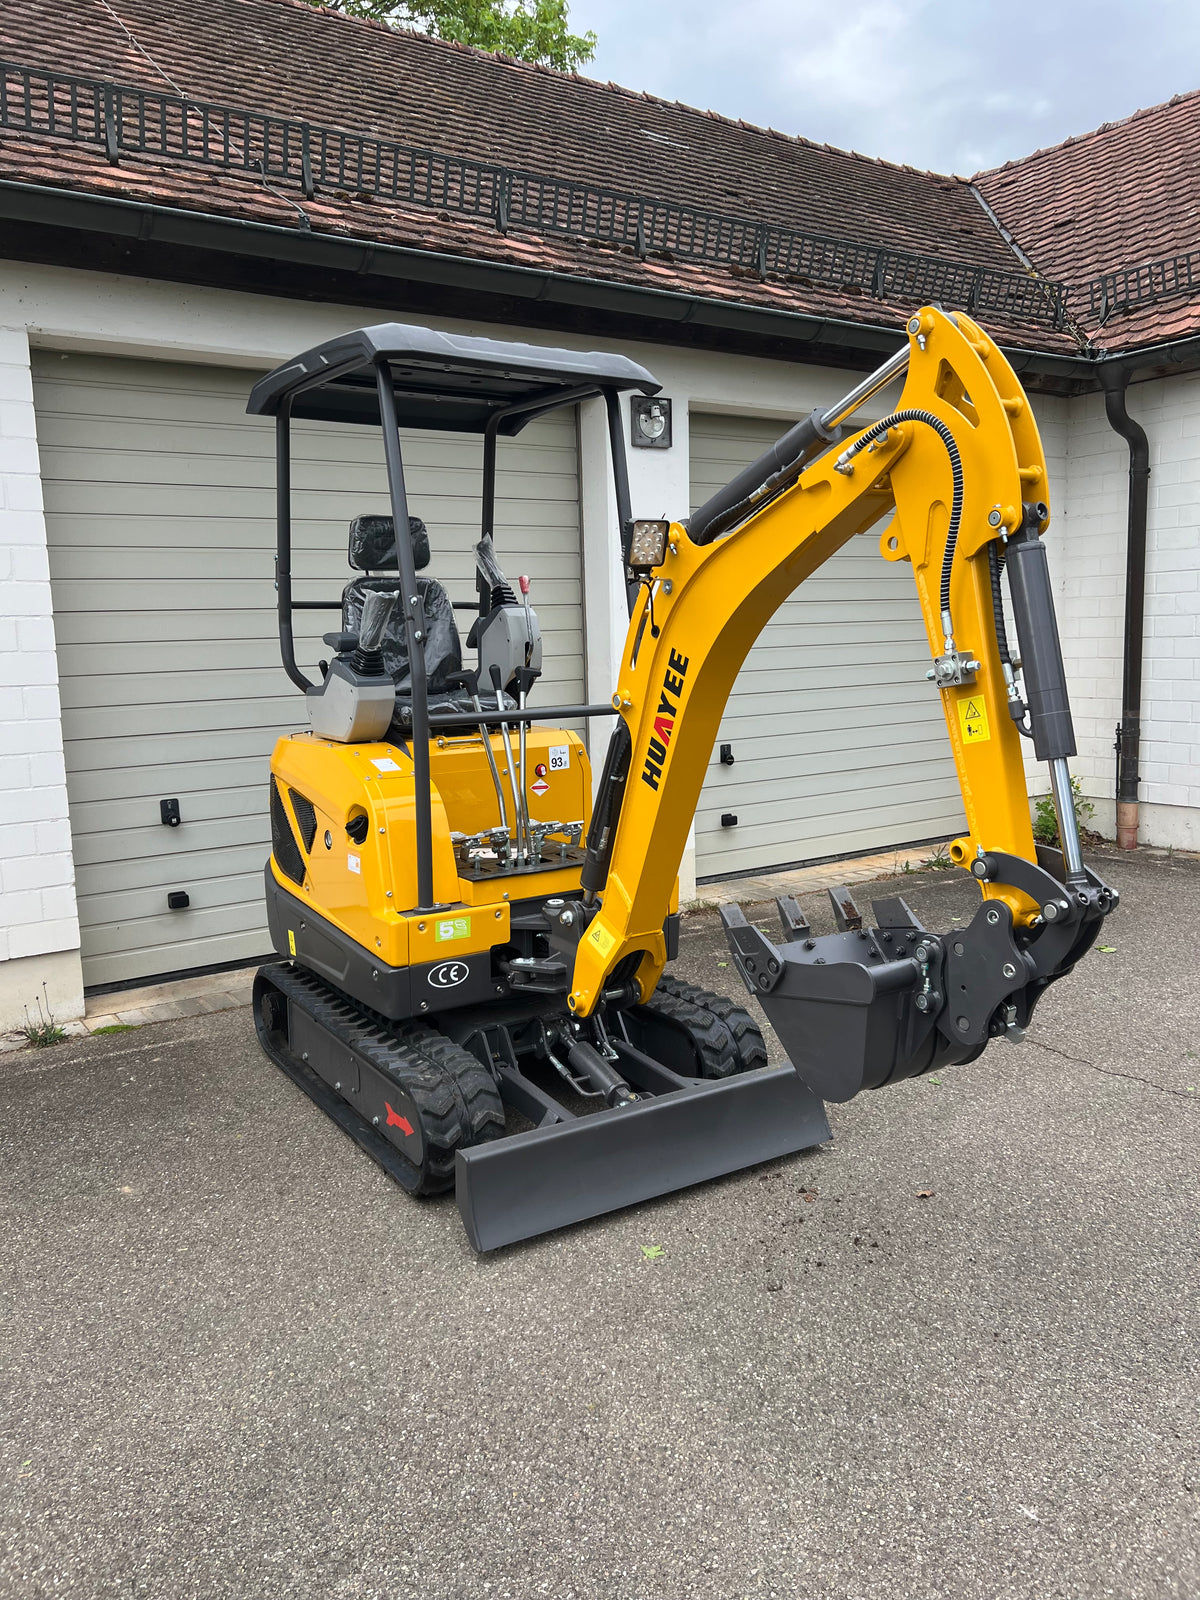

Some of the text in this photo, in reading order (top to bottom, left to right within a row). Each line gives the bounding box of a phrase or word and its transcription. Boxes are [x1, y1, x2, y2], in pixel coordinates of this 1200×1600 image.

[641, 648, 689, 791] HUAYEE
[551, 757, 562, 767] 93
[439, 965, 458, 983] CE
